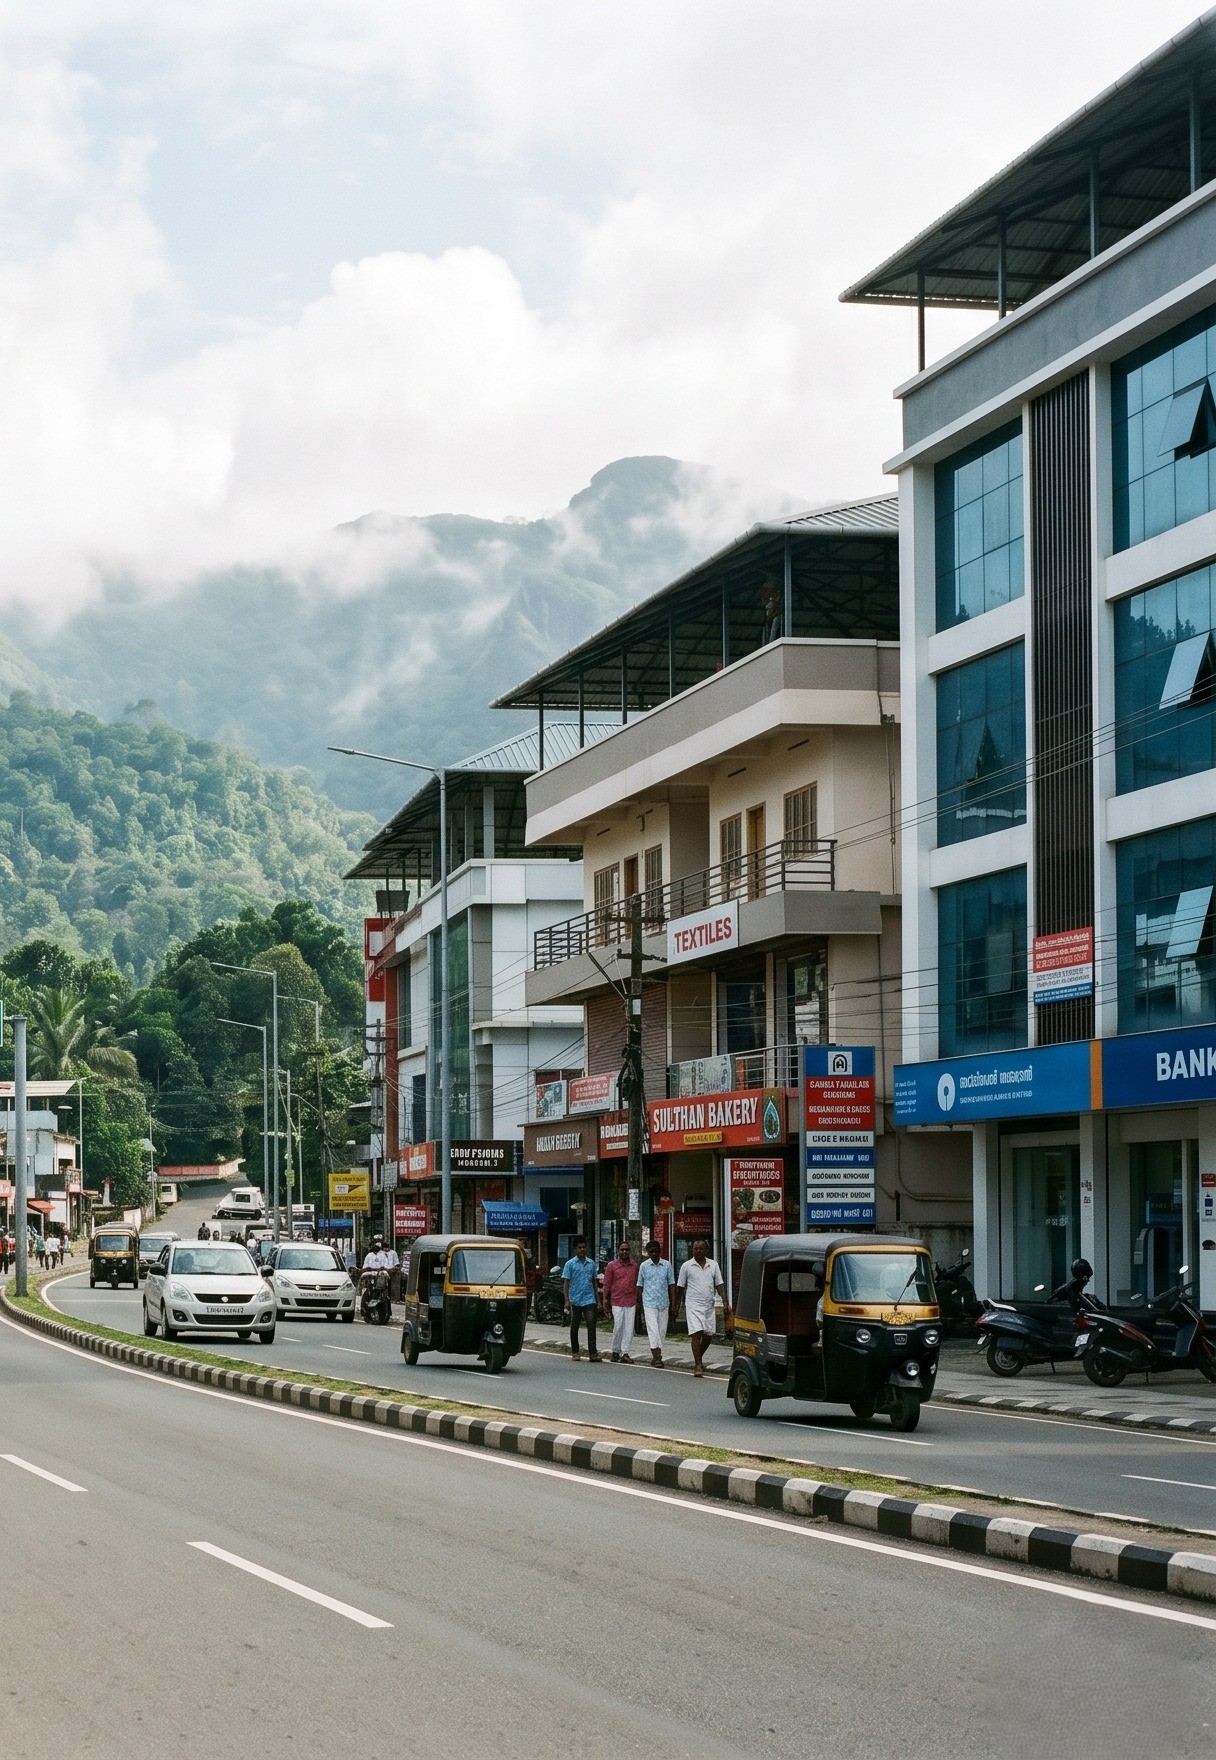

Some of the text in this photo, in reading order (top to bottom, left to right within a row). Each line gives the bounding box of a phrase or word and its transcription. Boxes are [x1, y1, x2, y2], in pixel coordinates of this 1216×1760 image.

[674, 917, 732, 953] TEXTILES
[653, 1097, 759, 1133] SULTHAN BAKERY
